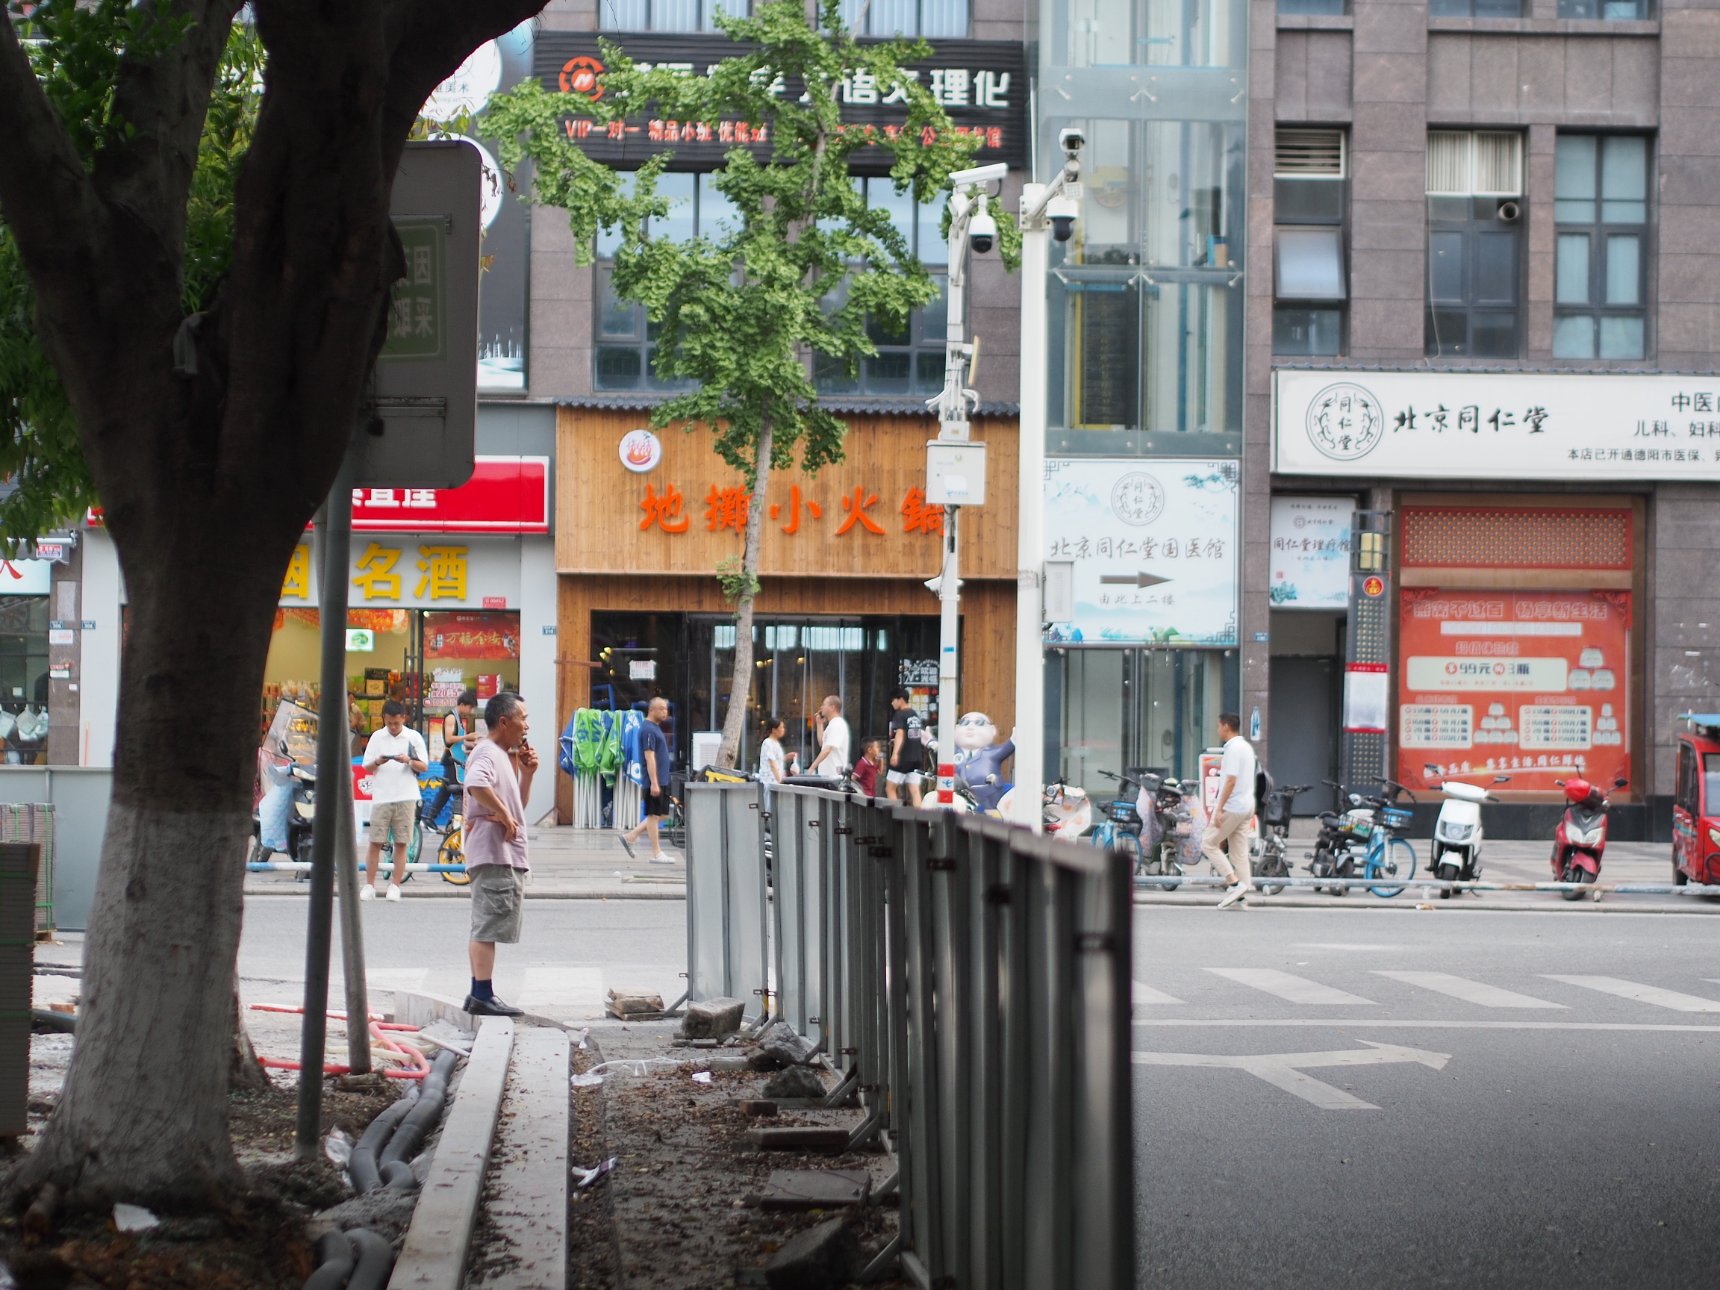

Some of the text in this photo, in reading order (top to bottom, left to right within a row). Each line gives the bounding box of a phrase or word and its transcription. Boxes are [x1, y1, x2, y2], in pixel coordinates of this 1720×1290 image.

[1671, 391, 1720, 413] 中医
[1394, 404, 1549, 434] 北京同仁堂
[1050, 536, 1226, 561] 北京同仁堂国医馆
[1099, 593, 1177, 607] 由此上二楼
